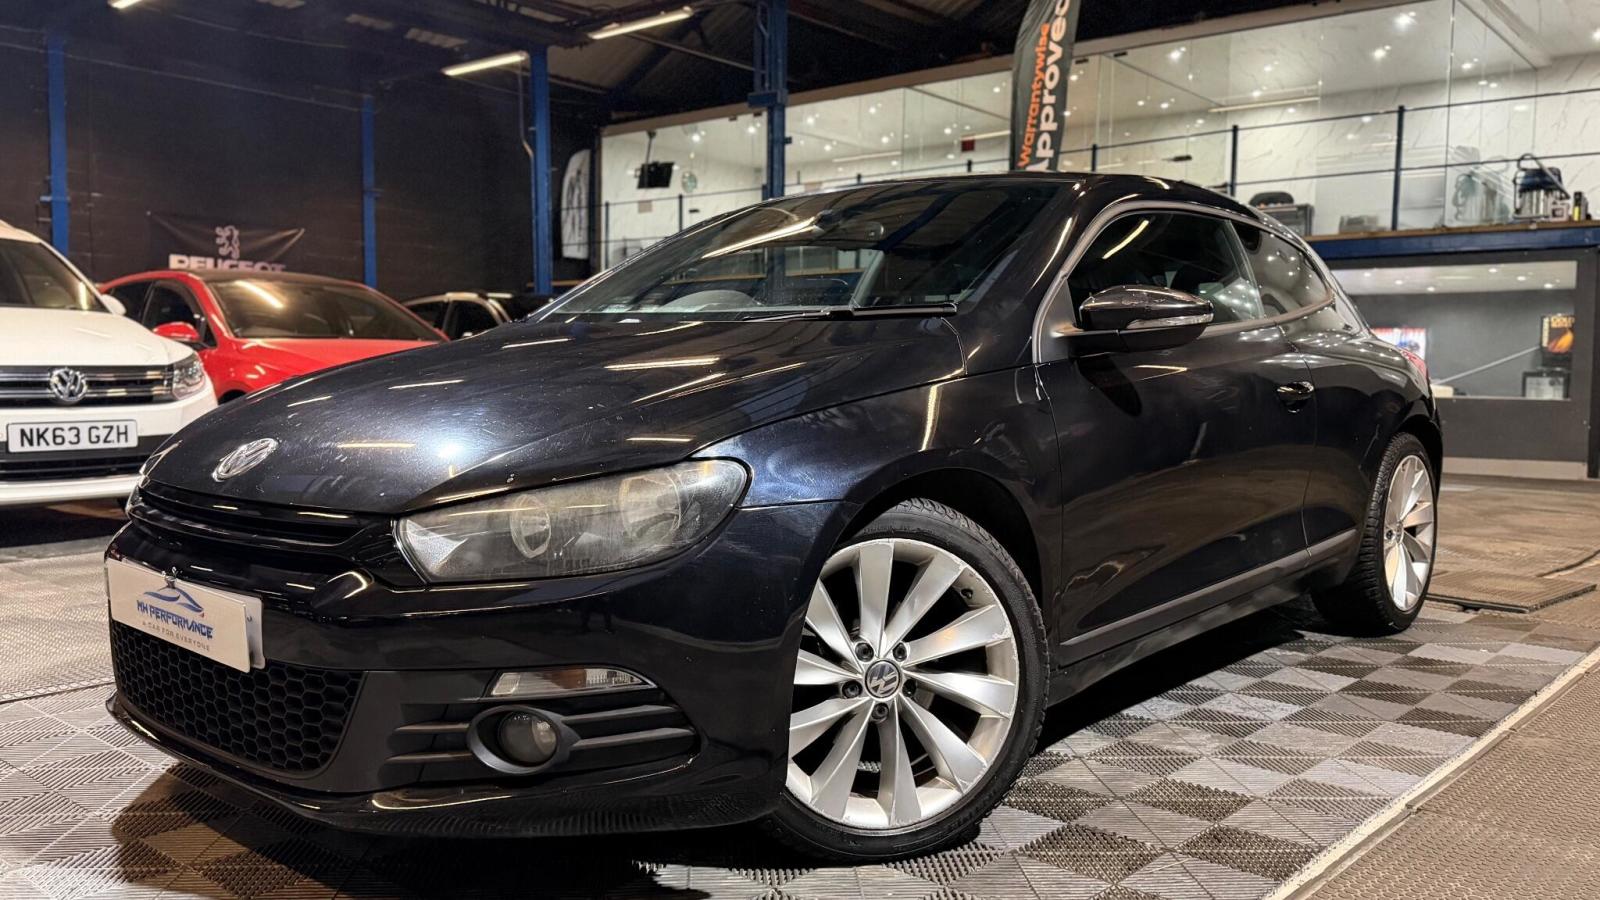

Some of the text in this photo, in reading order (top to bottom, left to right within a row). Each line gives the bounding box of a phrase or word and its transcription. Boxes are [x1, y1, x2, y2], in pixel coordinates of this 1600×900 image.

[1017, 22, 1050, 167] warrantywise
[20, 425, 128, 447] NK63 GZH
[149, 605, 213, 639] PERFORMANCE
